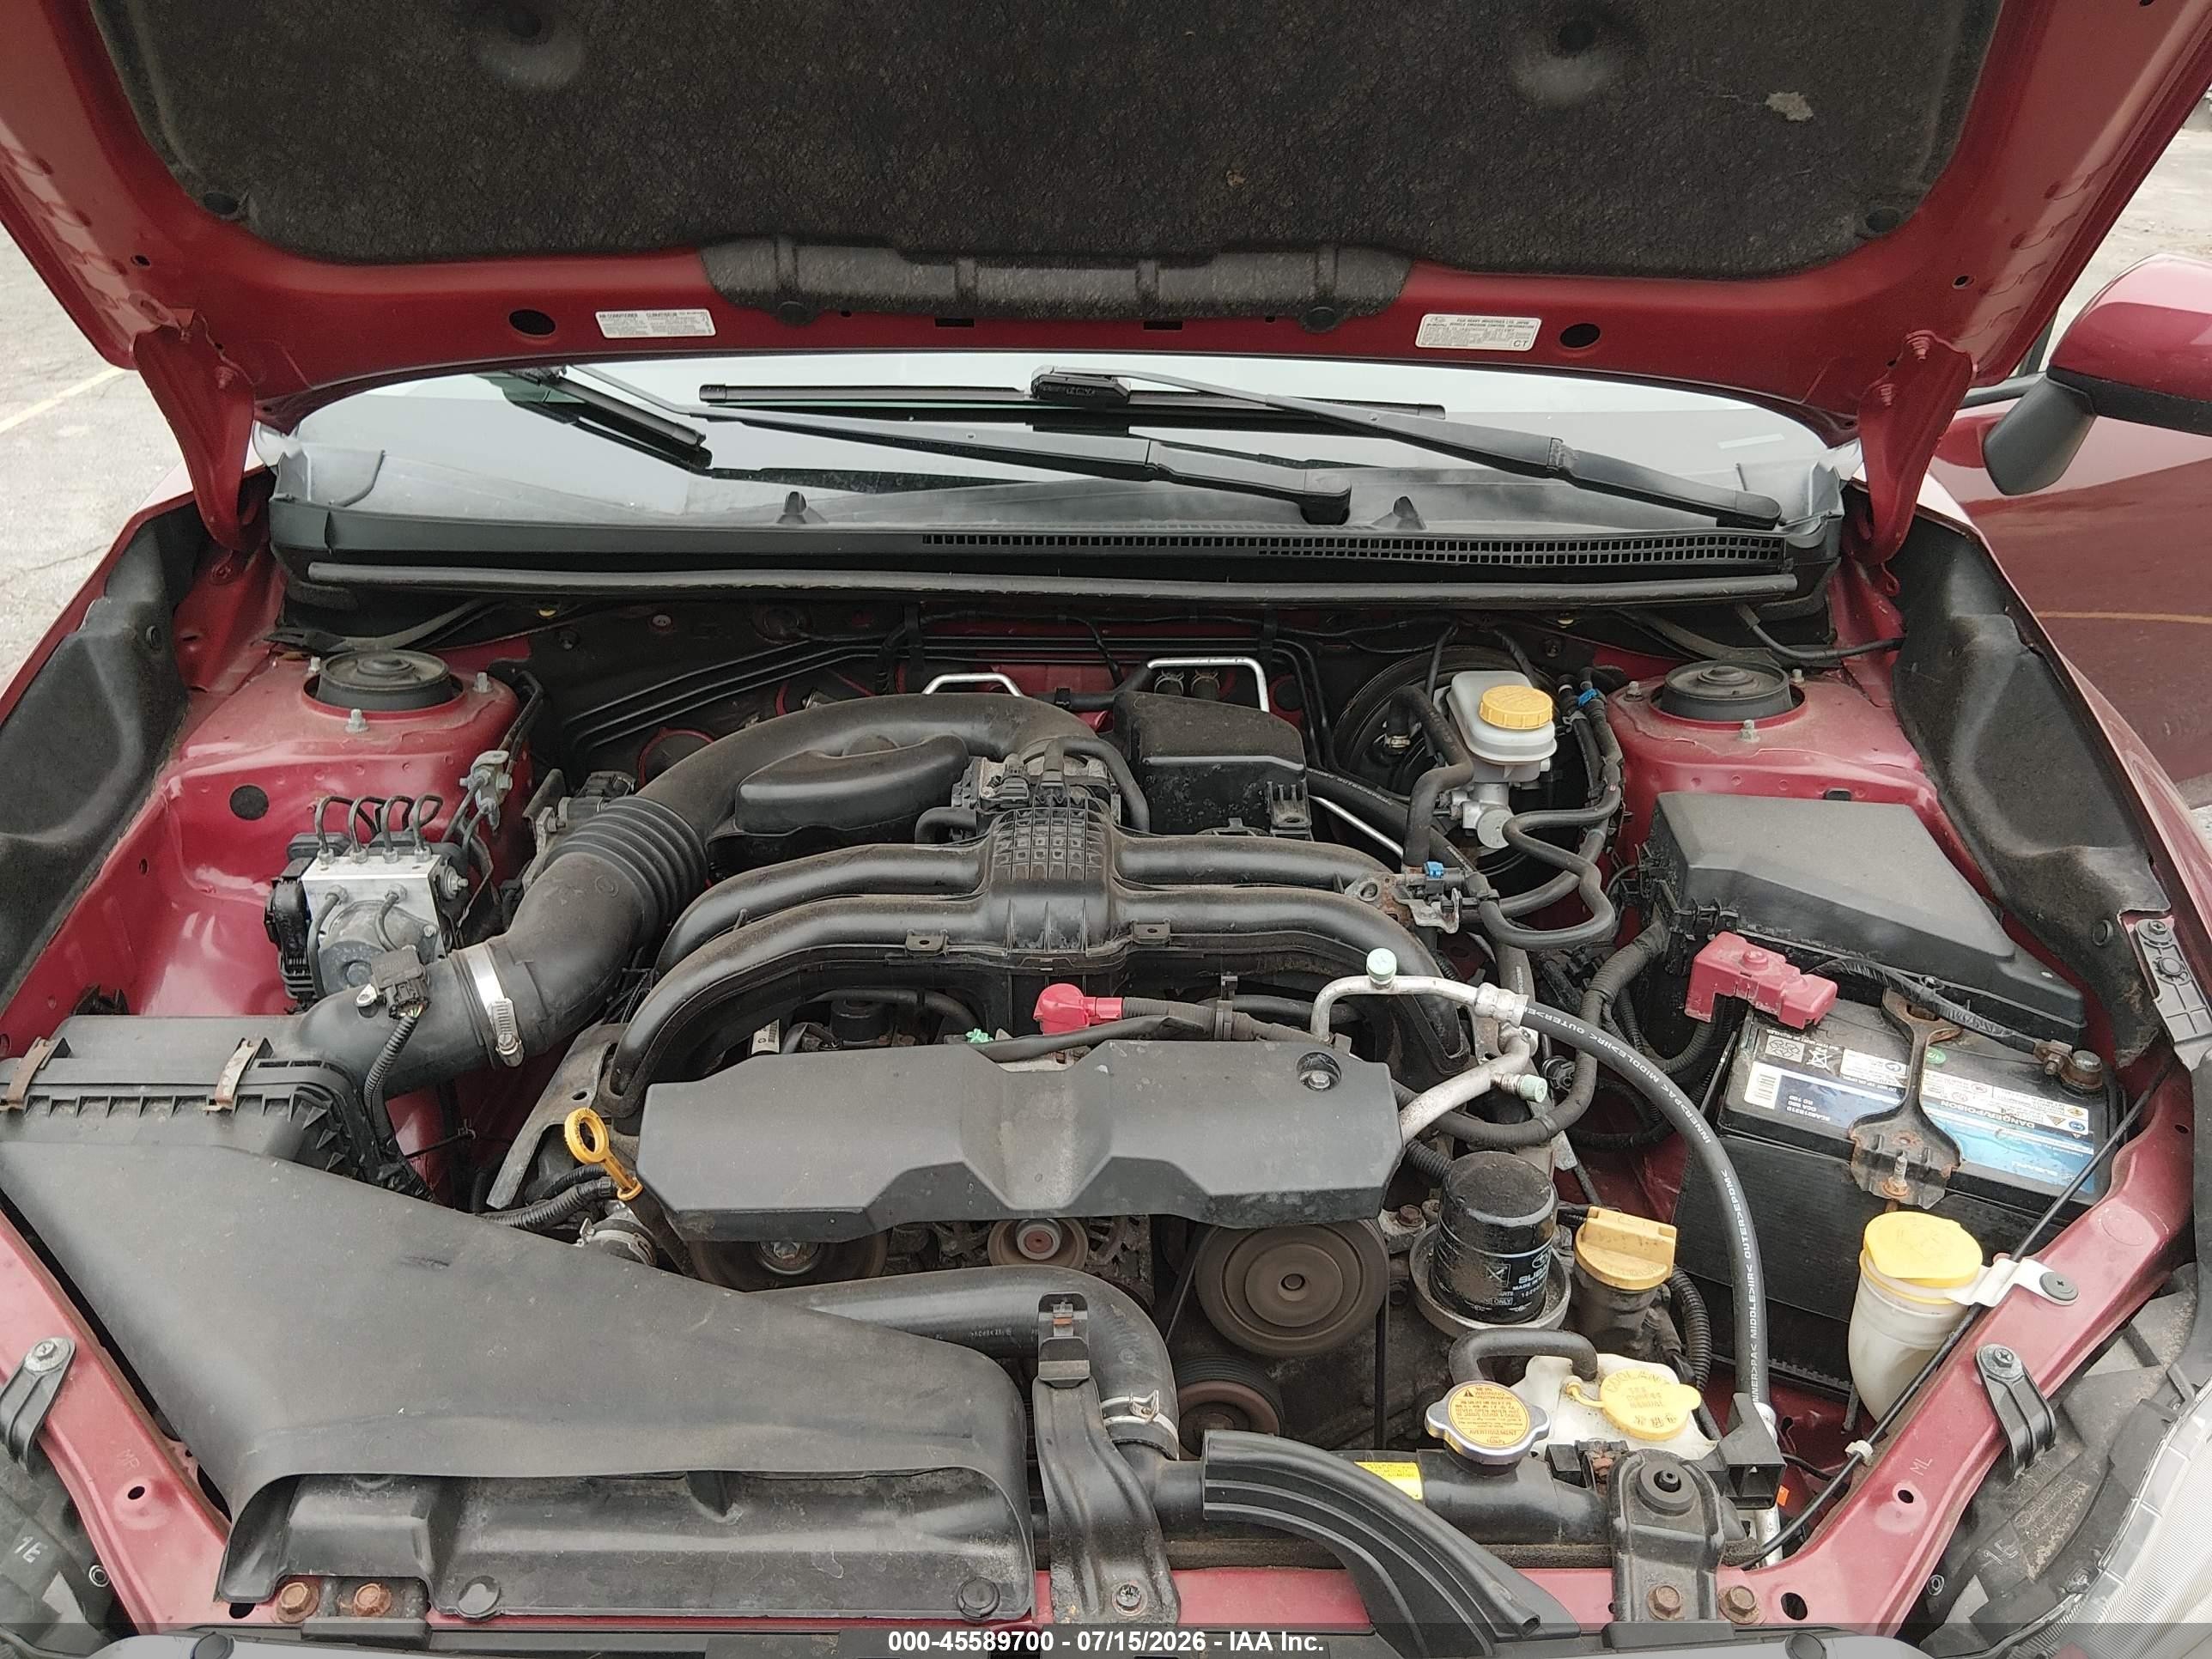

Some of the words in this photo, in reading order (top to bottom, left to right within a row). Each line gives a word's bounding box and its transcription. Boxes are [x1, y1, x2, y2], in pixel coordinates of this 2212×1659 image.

[1941, 1099, 2035, 1130] DANGER/POISON
[1512, 1281, 1532, 1291] MADE
[1604, 1370, 1670, 1394] COOLANT
[1909, 1458, 1933, 1476] ML
